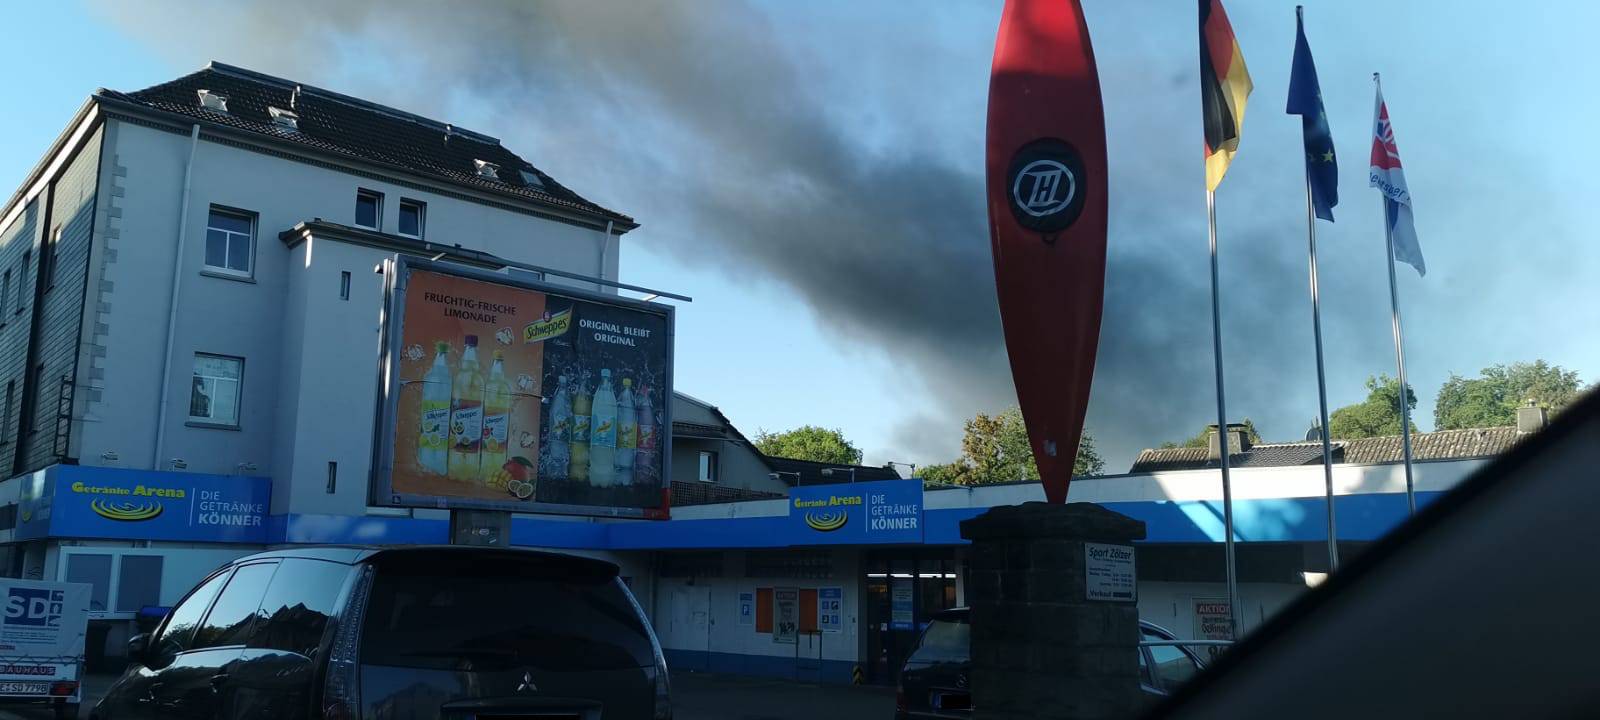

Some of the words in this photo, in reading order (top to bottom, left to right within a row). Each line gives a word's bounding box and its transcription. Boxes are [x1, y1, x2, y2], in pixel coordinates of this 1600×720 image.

[424, 292, 517, 316] FRUCHTIG-FRISCHE
[444, 308, 497, 324] LIMONADE
[527, 318, 568, 339] Schweppes
[579, 319, 621, 334] ORIGINAL
[623, 326, 652, 338] BLEIBT
[594, 333, 636, 347] ORIGINAL
[72, 482, 130, 496] Getränke
[133, 485, 185, 498] Arena
[201, 490, 220, 501] DIE
[829, 496, 862, 506] Arena
[871, 494, 886, 505] DIE
[199, 501, 263, 513] GETRÄNKE
[871, 503, 918, 516] GETRÄNKE
[198, 511, 262, 527] KÖNNER
[871, 515, 918, 530] KÖNNER
[1089, 547, 1108, 559] Sport
[1110, 549, 1131, 559] Zölzer
[5, 595, 48, 619] SD
[0, 665, 56, 675] BAUHAUS
